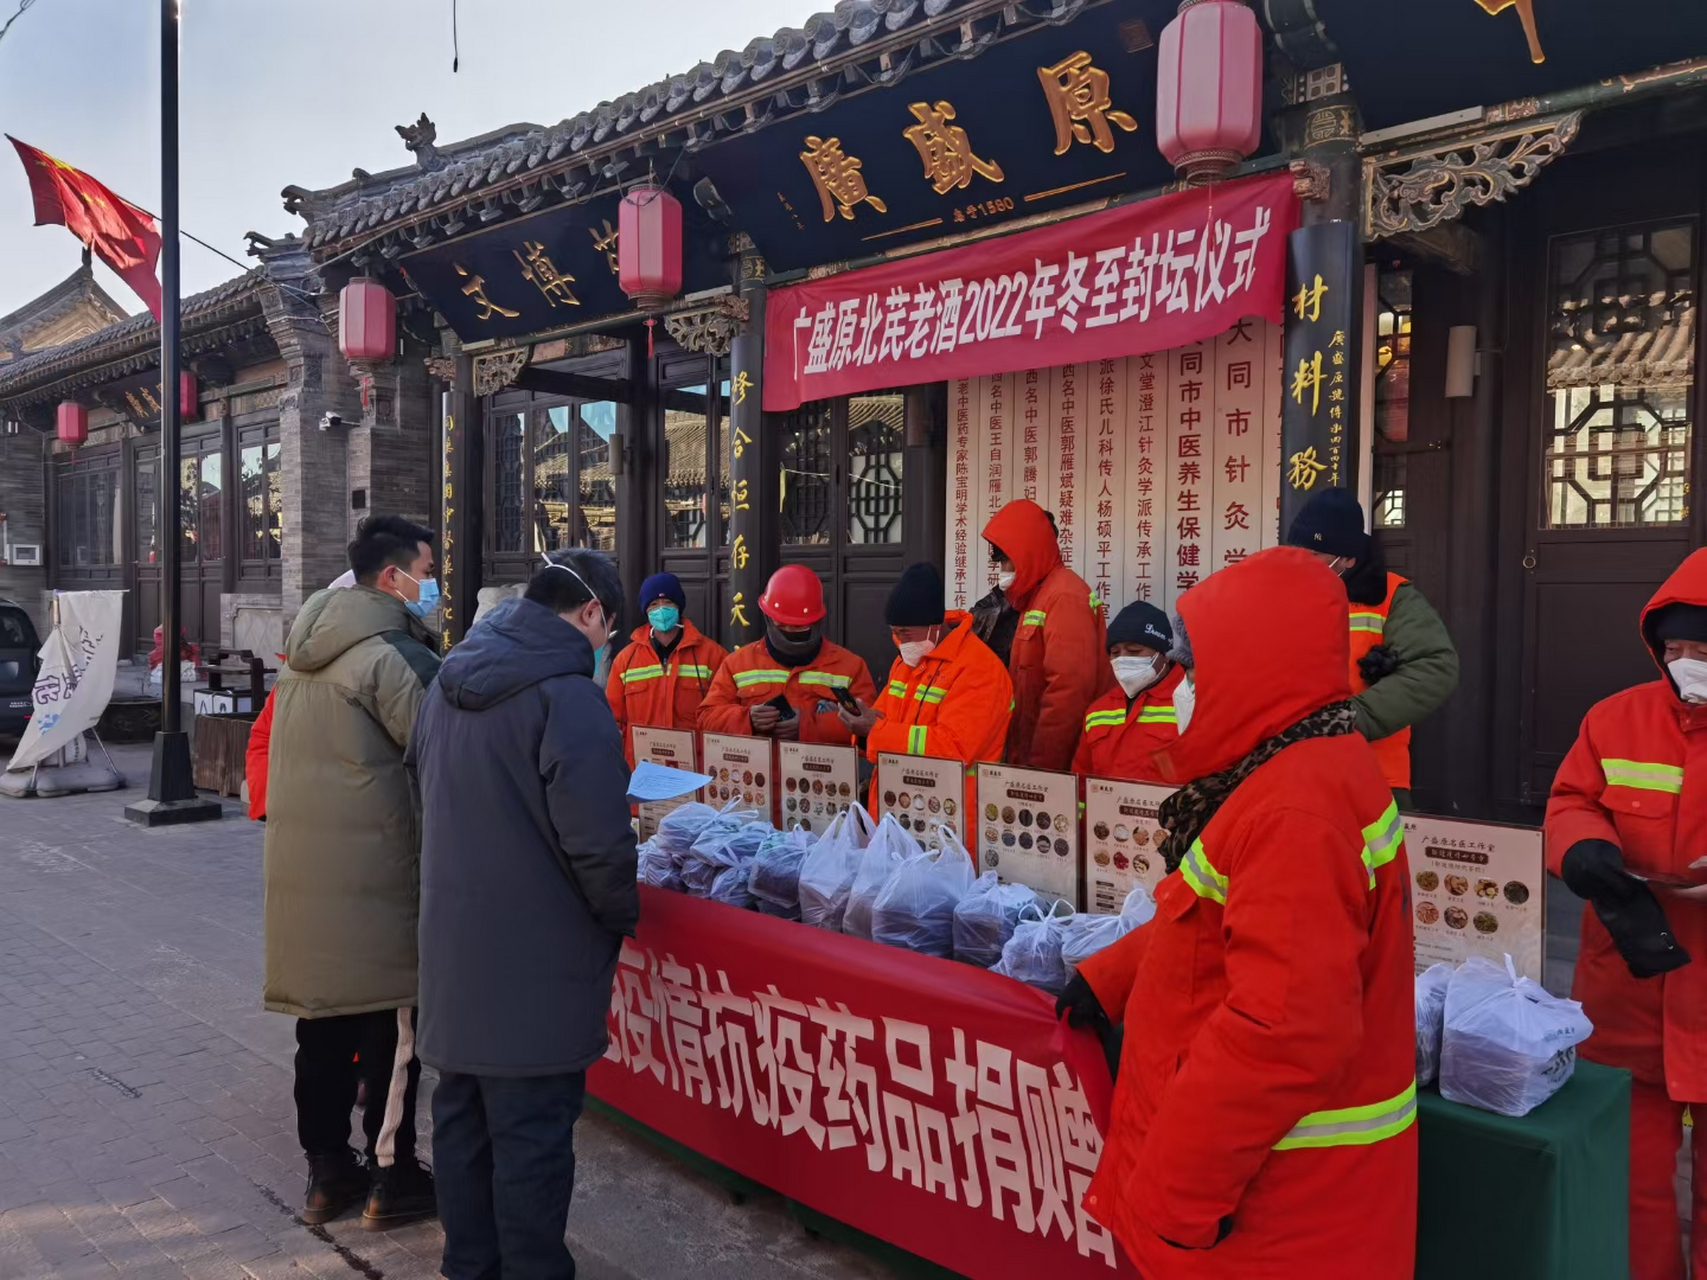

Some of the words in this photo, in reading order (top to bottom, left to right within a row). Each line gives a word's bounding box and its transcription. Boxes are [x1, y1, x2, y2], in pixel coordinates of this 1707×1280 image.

[793, 207, 1272, 381] 广盛原北芪老酒2022年冬至封坛仪式
[729, 371, 754, 650] 修合恒存天
[953, 376, 969, 610] 老中医药专家陈宝明学术经验继承工作
[1059, 363, 1075, 569] 西名中医郭雁斌疑难杂症
[1176, 340, 1203, 593] 同市中医养生保健学
